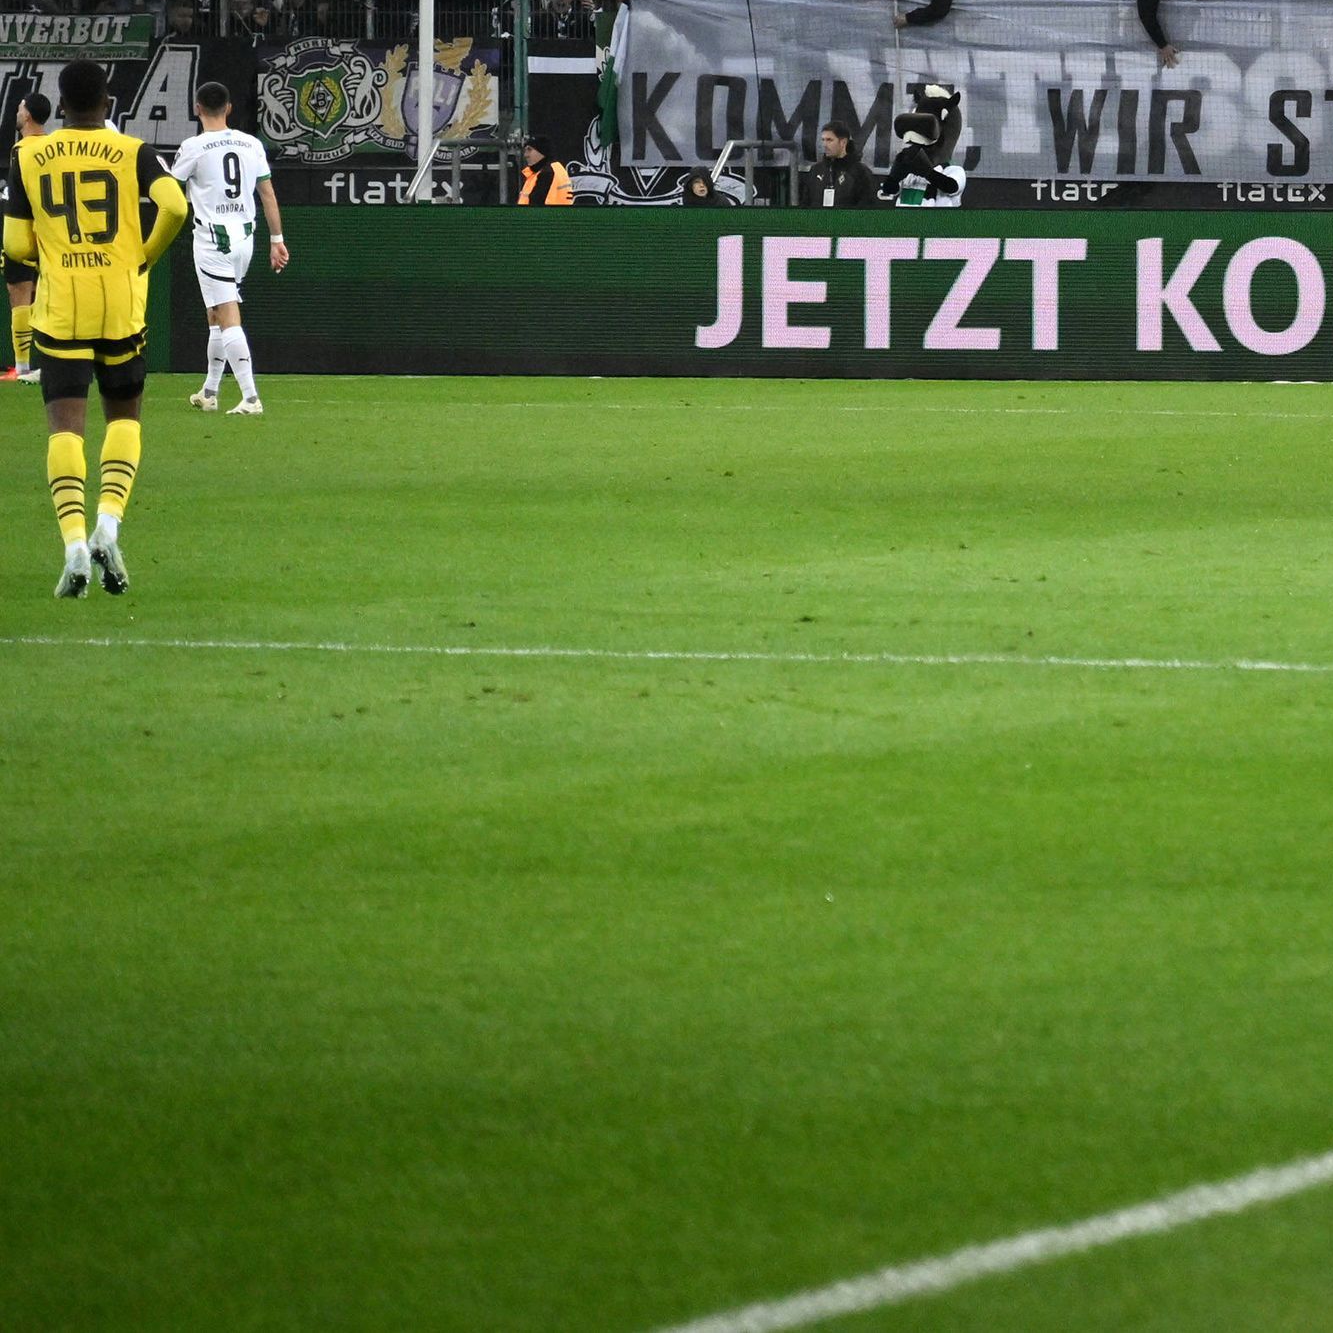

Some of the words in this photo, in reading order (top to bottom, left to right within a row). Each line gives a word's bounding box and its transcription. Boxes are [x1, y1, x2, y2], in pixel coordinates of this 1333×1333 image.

[34, 140, 124, 167] DORTMUND
[631, 72, 982, 172] KOMM,
[1048, 88, 1203, 176] WIR
[223, 151, 242, 199] 9
[40, 169, 119, 244] 43
[61, 252, 112, 268] GITTENS
[695, 235, 1088, 350] JETZT
